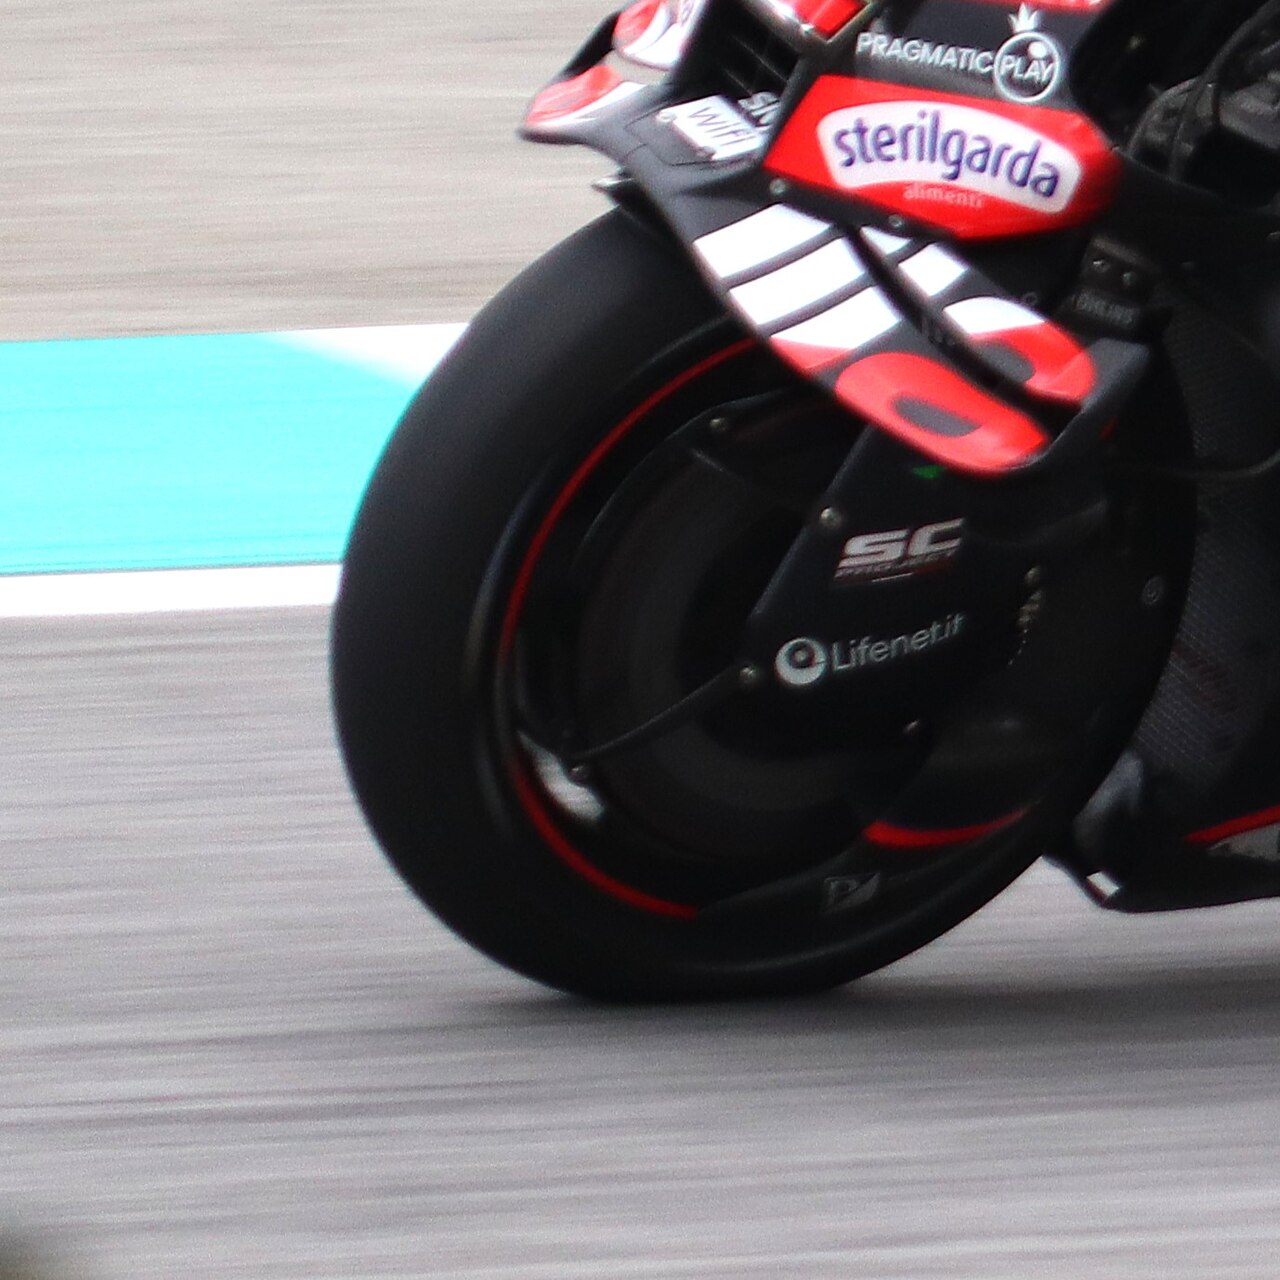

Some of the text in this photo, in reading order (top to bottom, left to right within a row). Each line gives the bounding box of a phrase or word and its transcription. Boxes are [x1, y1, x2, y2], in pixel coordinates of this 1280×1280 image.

[856, 30, 1055, 84] PRAGMATIC PLAY
[833, 108, 1061, 199] sterilgarda
[837, 518, 966, 569] SC
[831, 611, 967, 671] Lifenet.it
